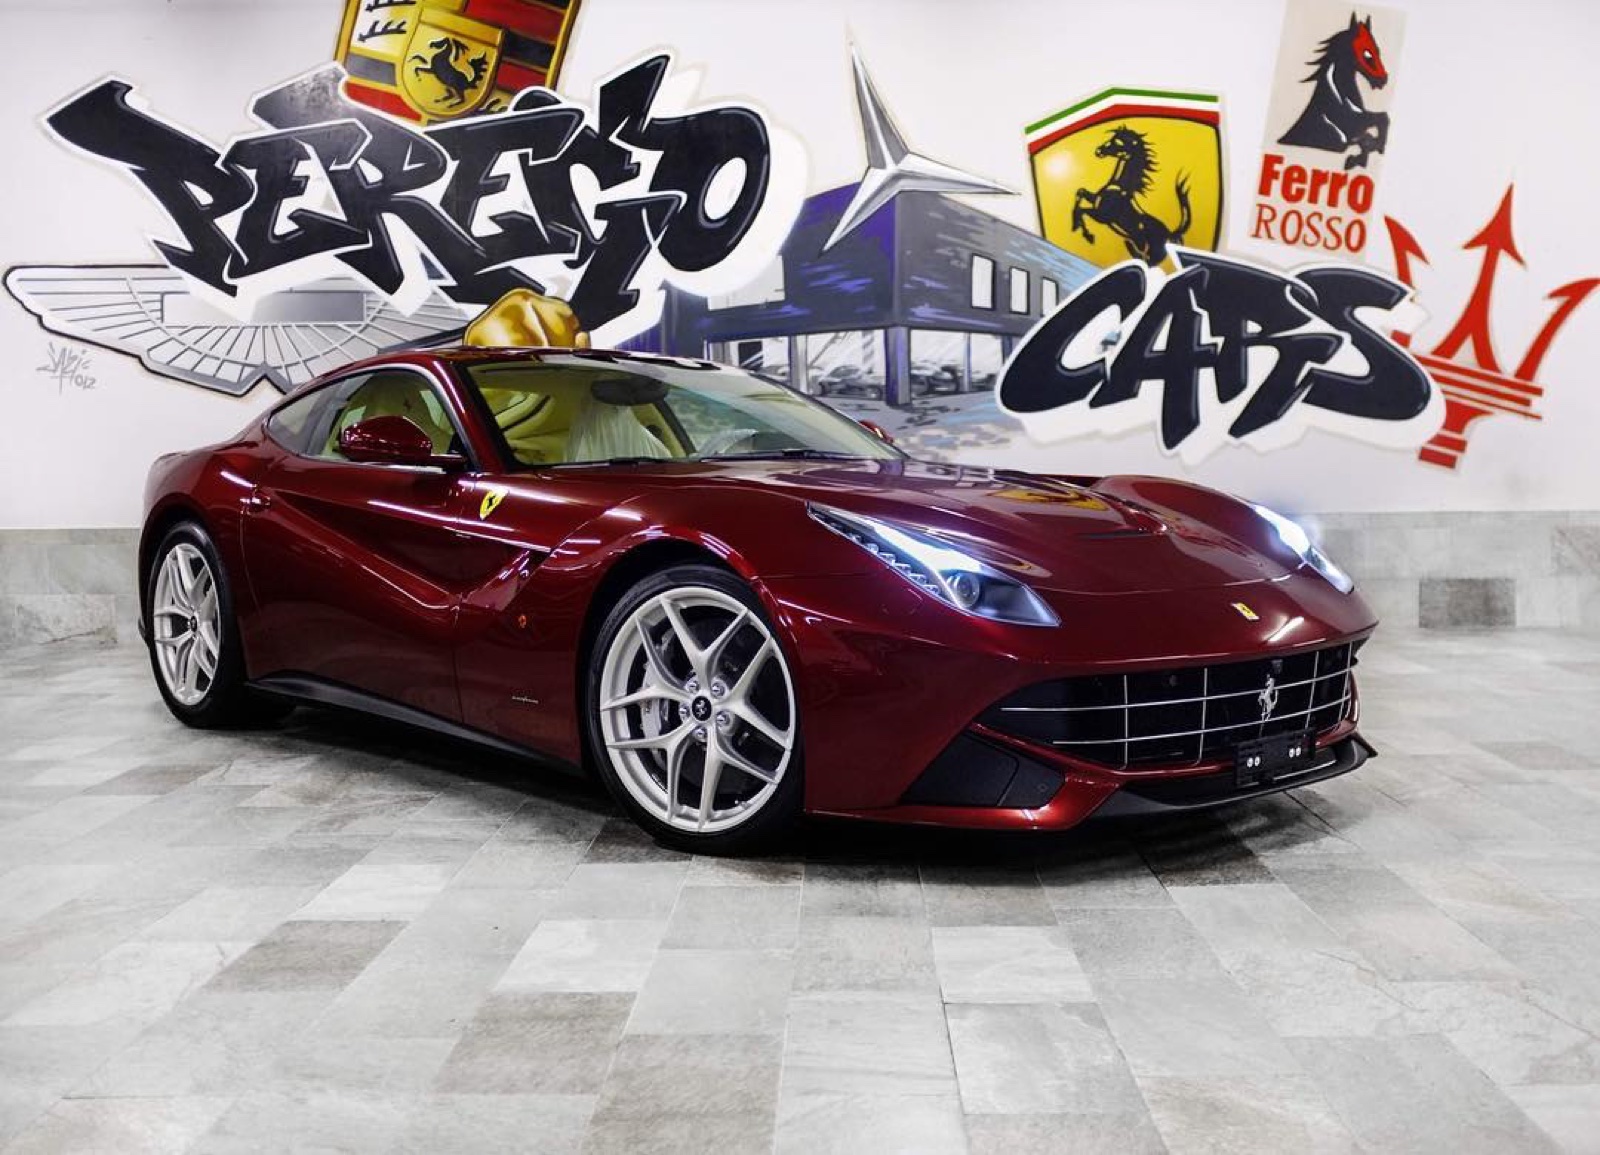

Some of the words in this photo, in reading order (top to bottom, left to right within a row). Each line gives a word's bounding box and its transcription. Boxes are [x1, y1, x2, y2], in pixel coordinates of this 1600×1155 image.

[47, 54, 770, 331] PEREGO
[1251, 203, 1367, 253] ROSSO
[1258, 154, 1375, 214] Ferro
[1000, 250, 1431, 449] CARS
